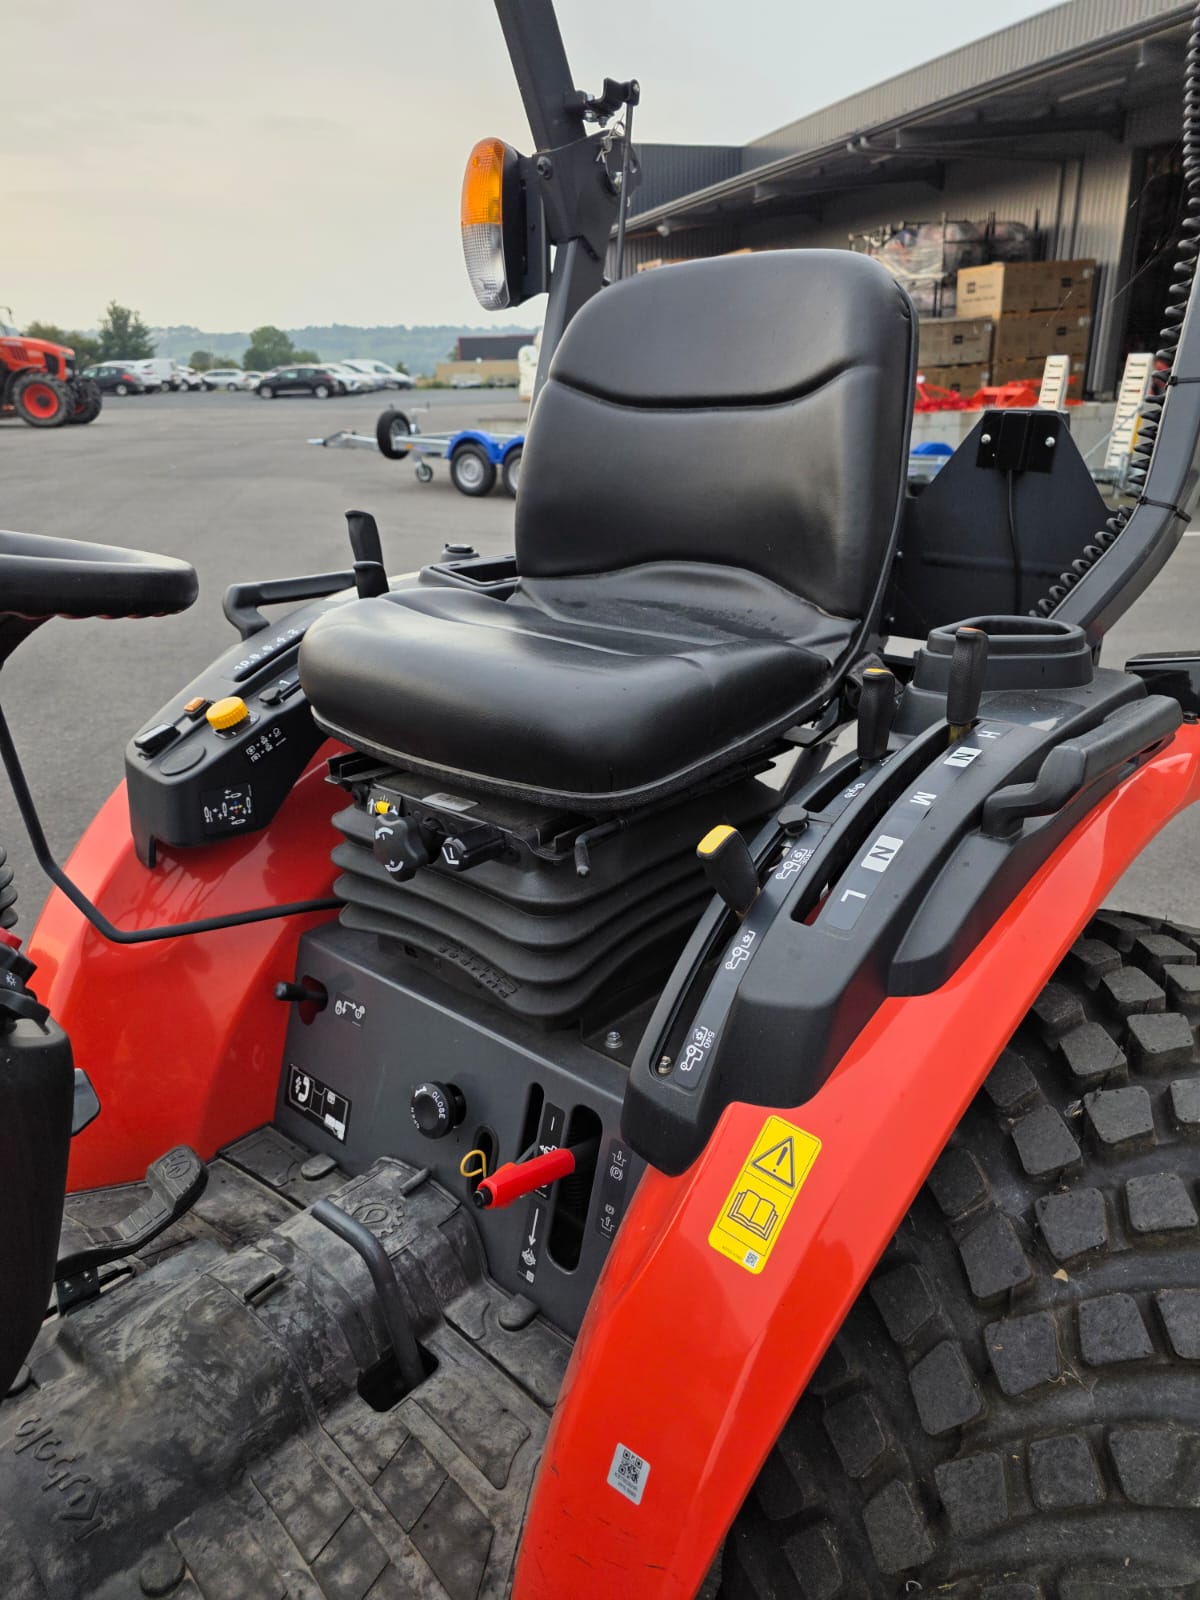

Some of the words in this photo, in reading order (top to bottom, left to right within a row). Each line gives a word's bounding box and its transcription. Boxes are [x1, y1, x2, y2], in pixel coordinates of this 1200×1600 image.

[978, 730, 1001, 739] H
[951, 752, 974, 762] N
[909, 791, 937, 806] M
[869, 845, 893, 861] N
[840, 889, 867, 902] L
[703, 1030, 716, 1049] 540
